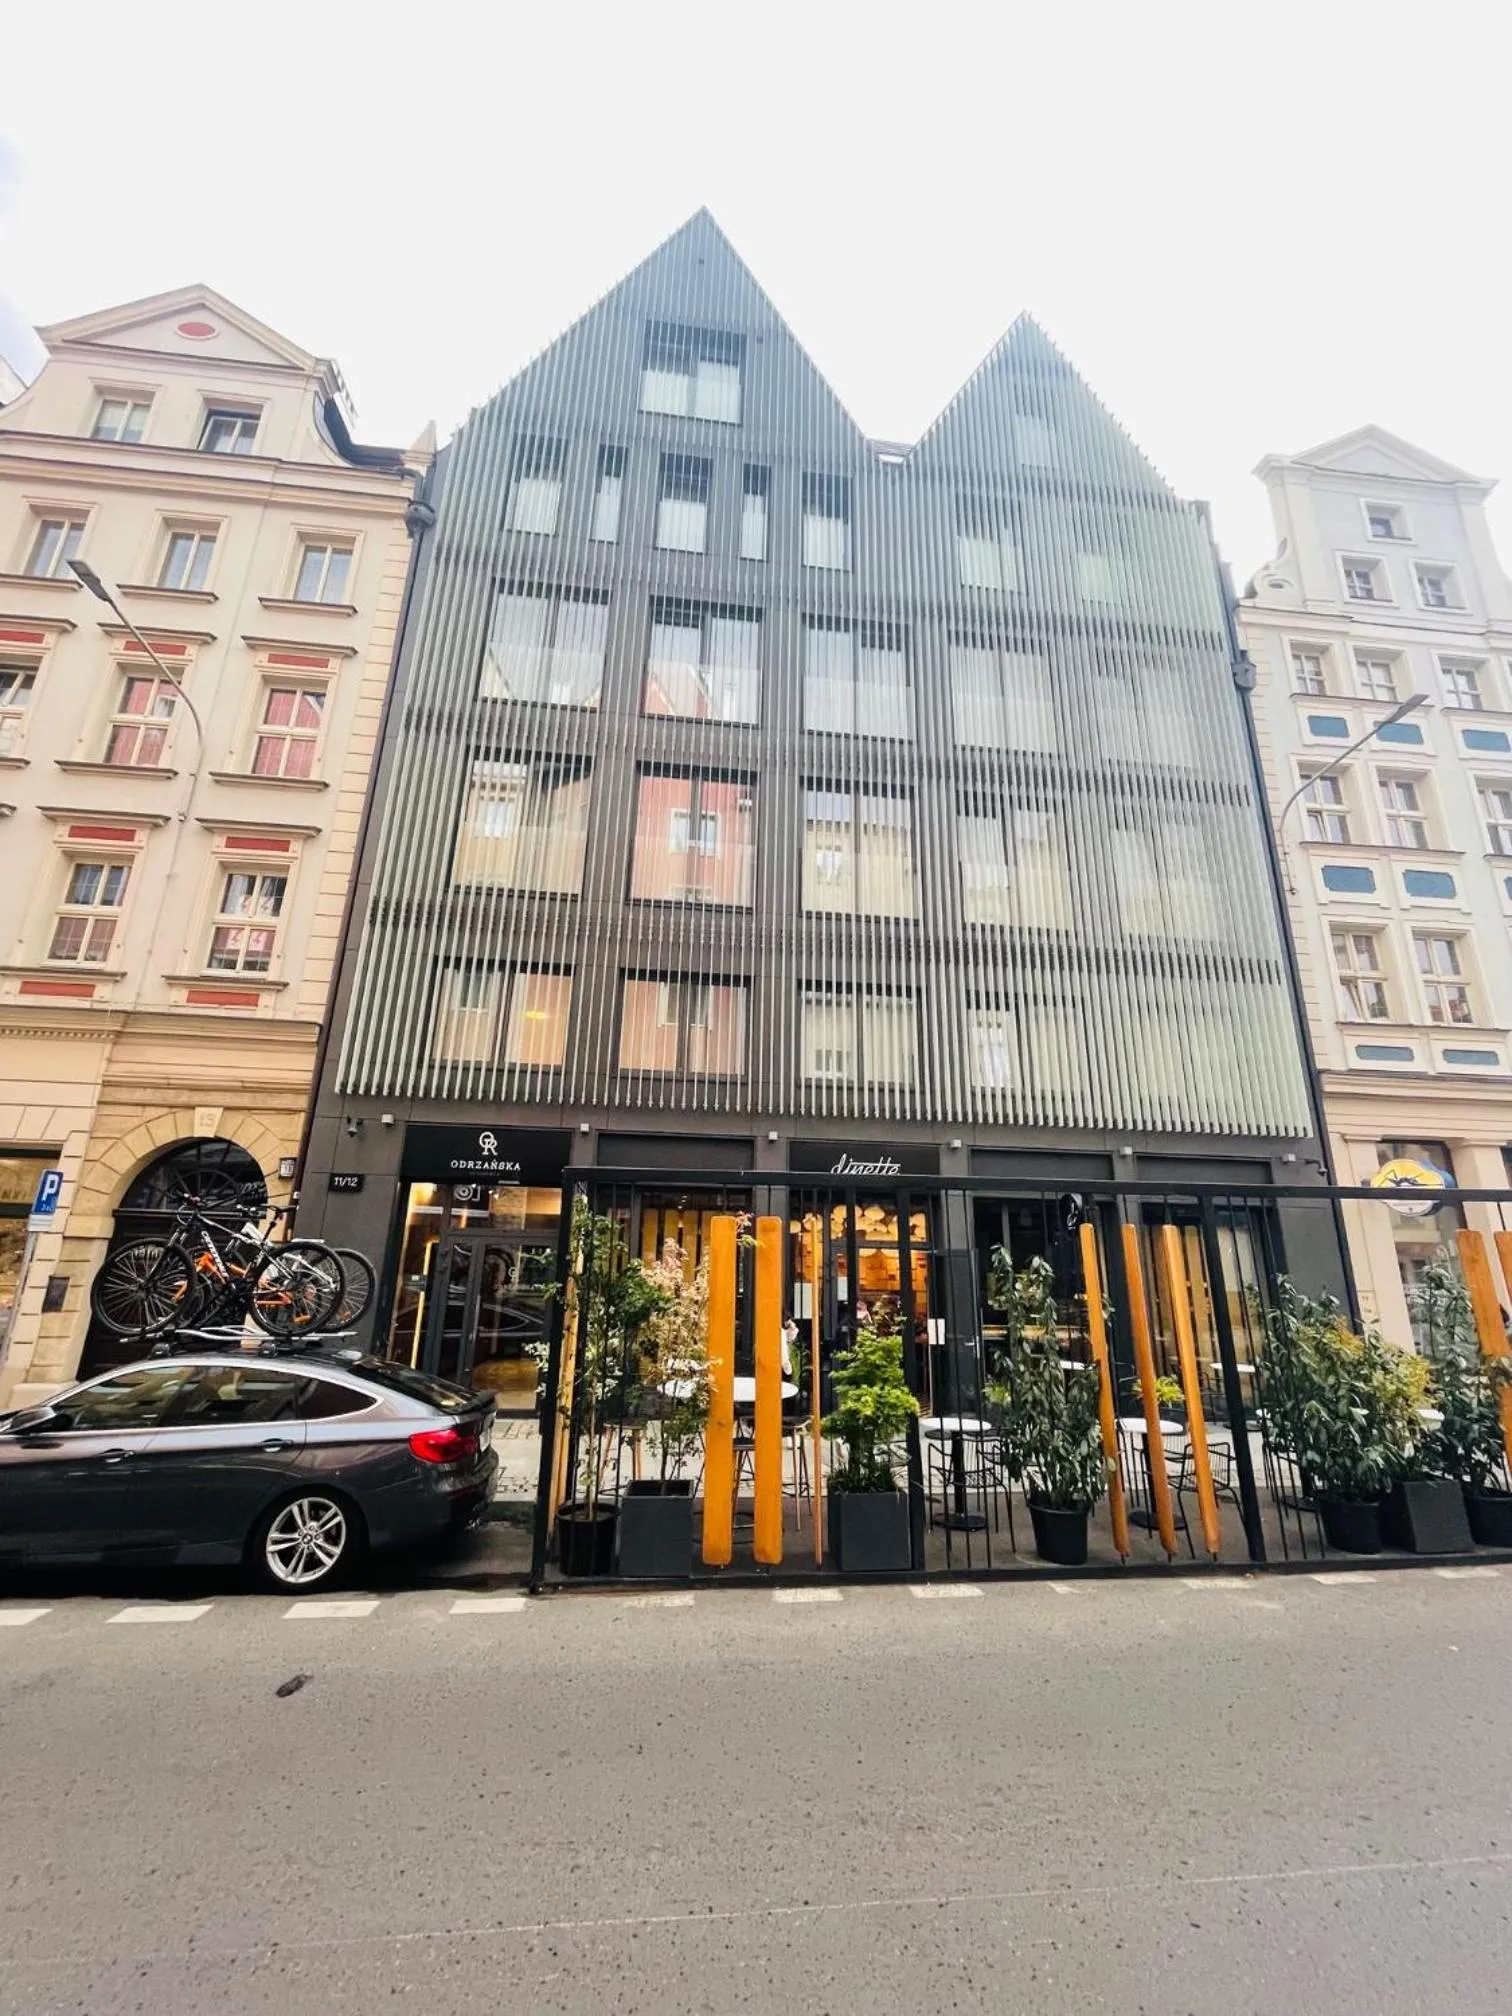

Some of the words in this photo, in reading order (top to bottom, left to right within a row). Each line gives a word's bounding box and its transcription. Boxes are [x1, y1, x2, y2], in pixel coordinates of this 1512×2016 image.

[450, 1159, 521, 1171] ODRZAŃSKA
[830, 1152, 901, 1176] dinette
[42, 1174, 60, 1201] P
[334, 1176, 358, 1187] 11/12
